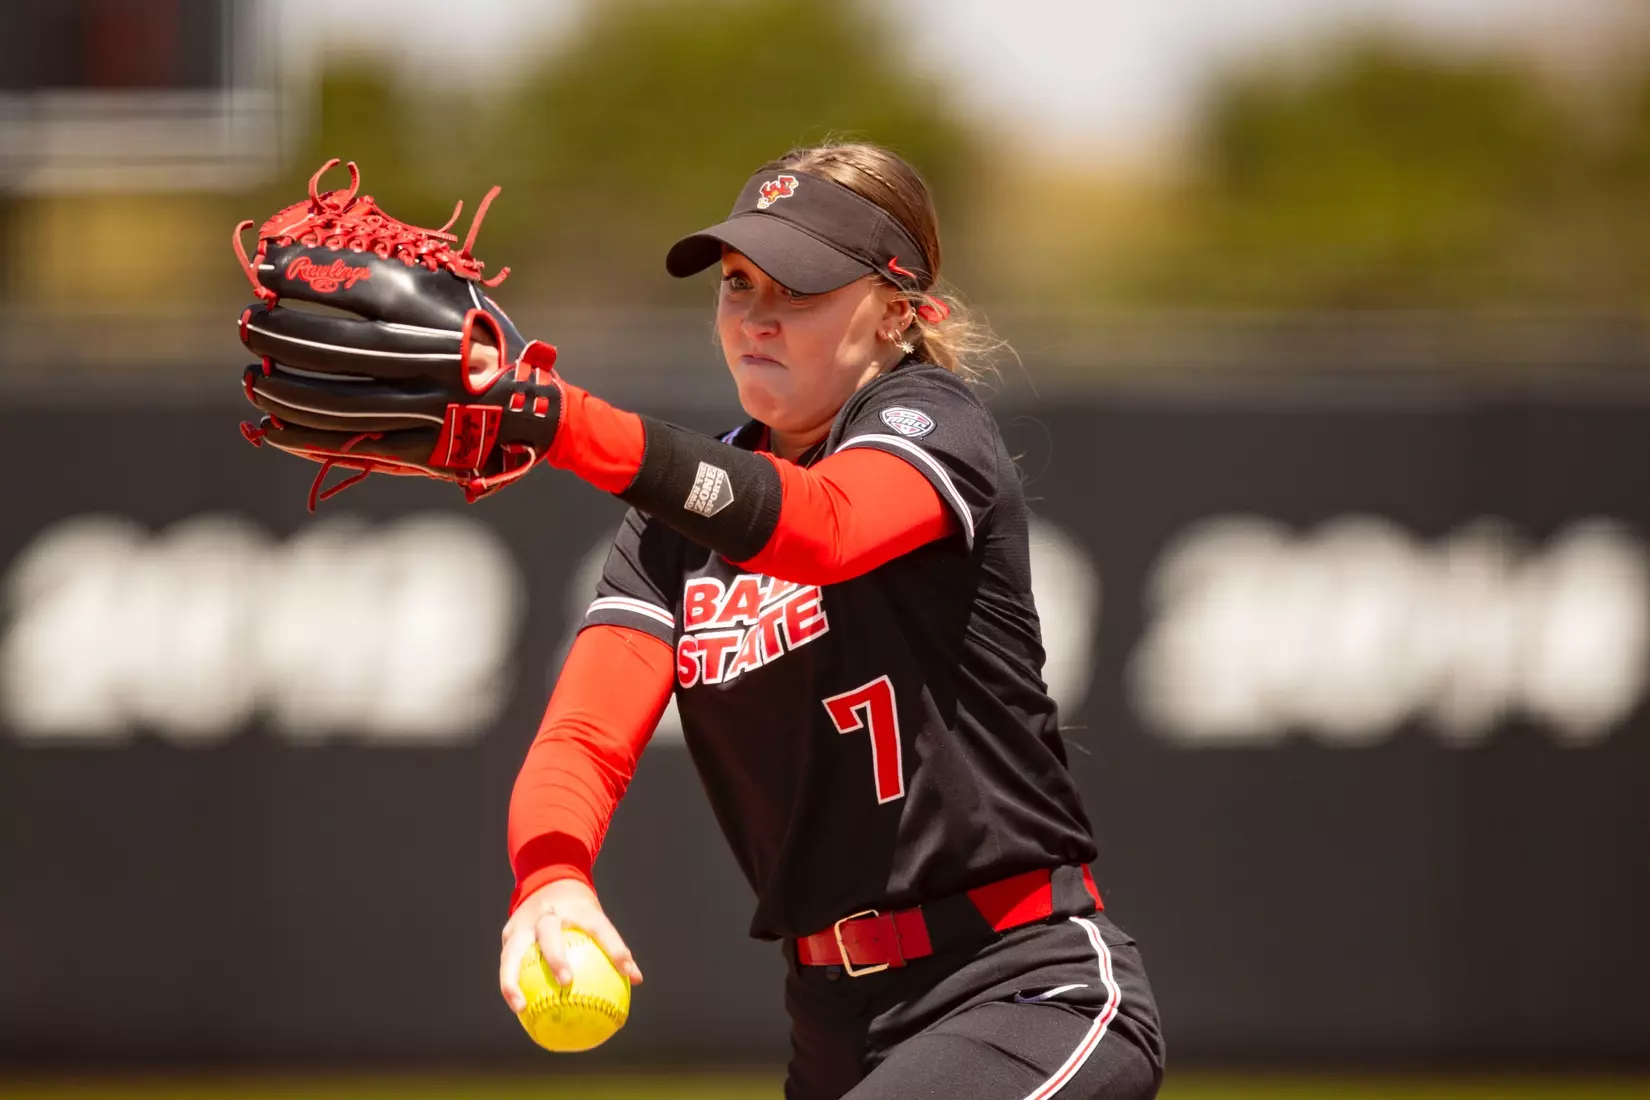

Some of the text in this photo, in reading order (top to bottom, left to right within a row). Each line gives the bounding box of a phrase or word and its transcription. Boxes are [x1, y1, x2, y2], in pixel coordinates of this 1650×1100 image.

[285, 256, 371, 289] Rawlings
[694, 467, 717, 512] ZONE
[704, 470, 725, 515] SPORTS
[683, 573, 799, 632] BAL
[677, 584, 830, 690] STATE
[821, 674, 905, 805] 7
